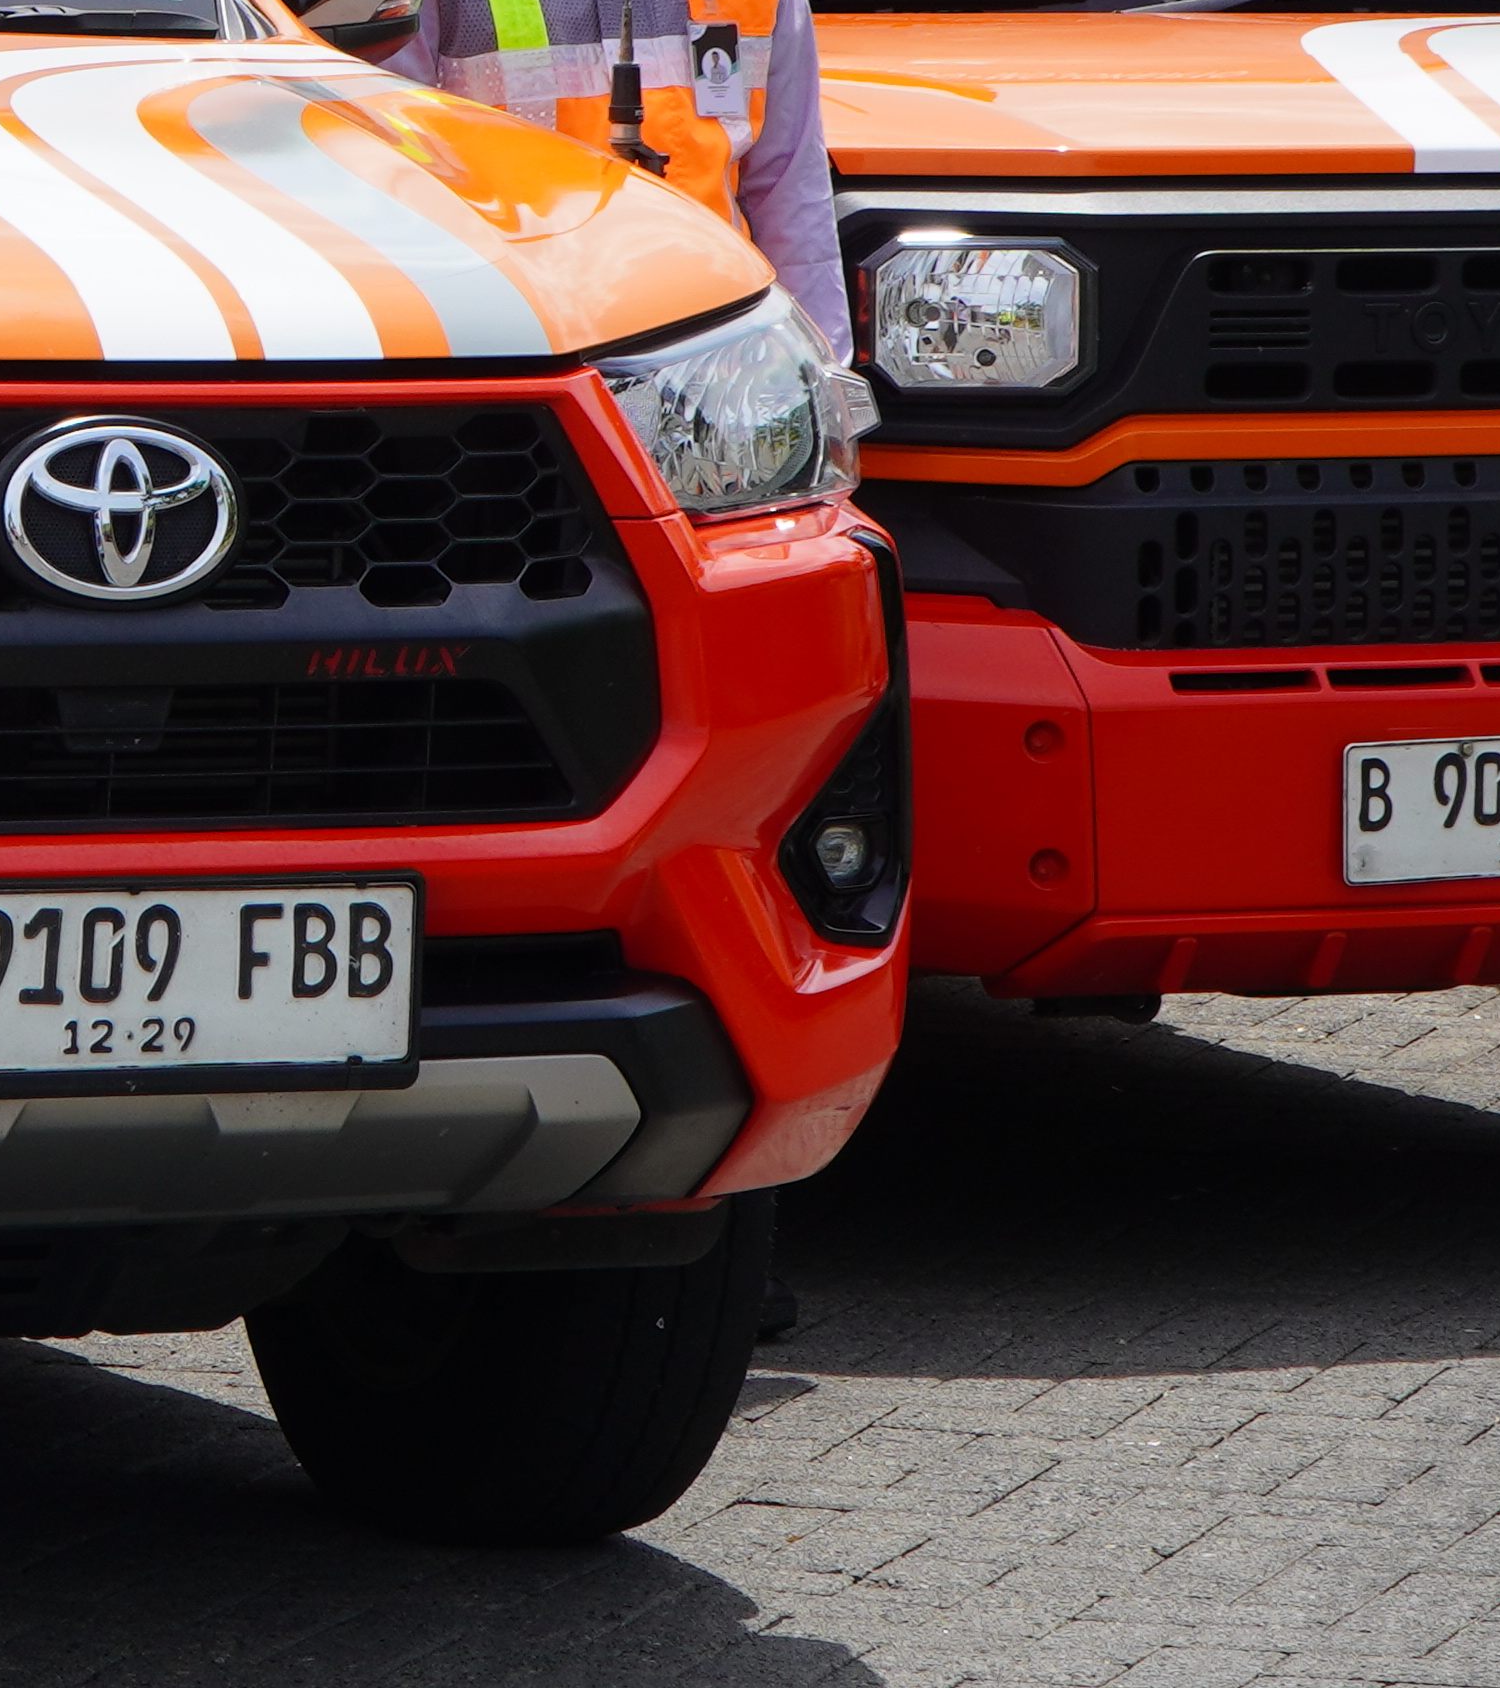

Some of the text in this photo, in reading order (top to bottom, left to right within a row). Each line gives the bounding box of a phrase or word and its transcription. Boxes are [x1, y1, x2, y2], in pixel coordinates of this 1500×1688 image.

[305, 645, 468, 679] HILUX
[1358, 756, 1394, 834] B
[237, 900, 395, 1000] FBB
